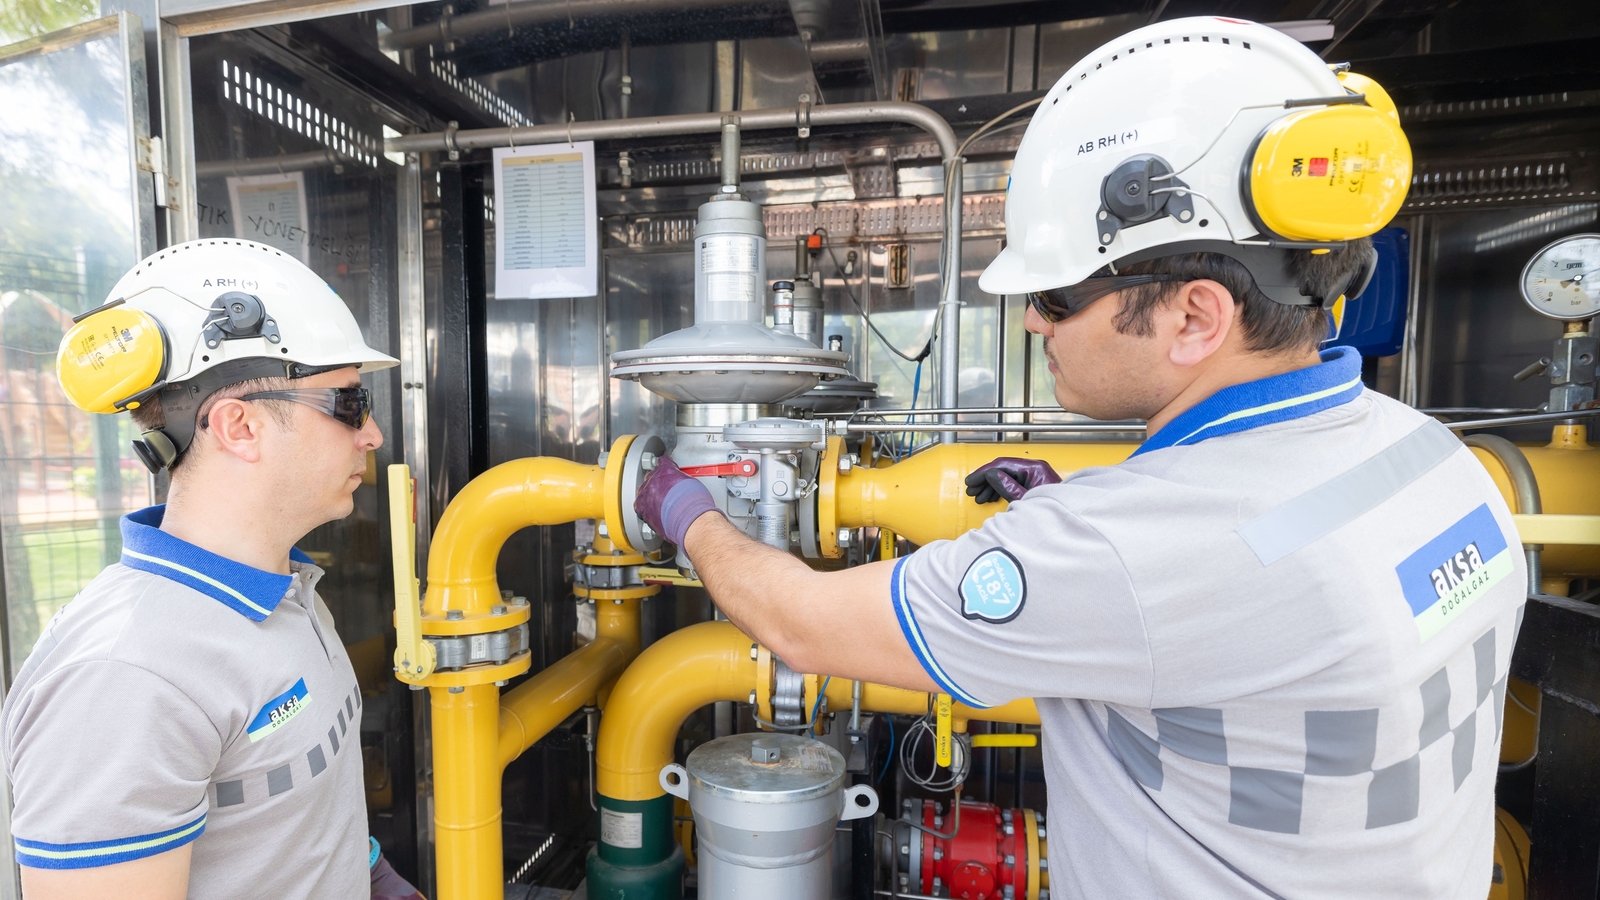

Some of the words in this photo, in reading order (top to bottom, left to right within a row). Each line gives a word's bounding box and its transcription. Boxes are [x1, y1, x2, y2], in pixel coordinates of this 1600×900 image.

[1077, 141, 1094, 156] AB
[1098, 134, 1117, 149] RH
[1121, 129, 1139, 145] (+)
[1291, 158, 1304, 177] 3M
[1329, 148, 1338, 186] PELTOR
[202, 279, 213, 288] A
[216, 278, 237, 287] RH
[241, 279, 259, 290] (+)
[111, 326, 127, 353] PELTOR
[120, 328, 133, 343] 3M
[1430, 542, 1484, 599] aksa
[982, 568, 1011, 604] 187
[1441, 570, 1490, 616] DOĞALGAZ
[269, 694, 299, 721] aksa
